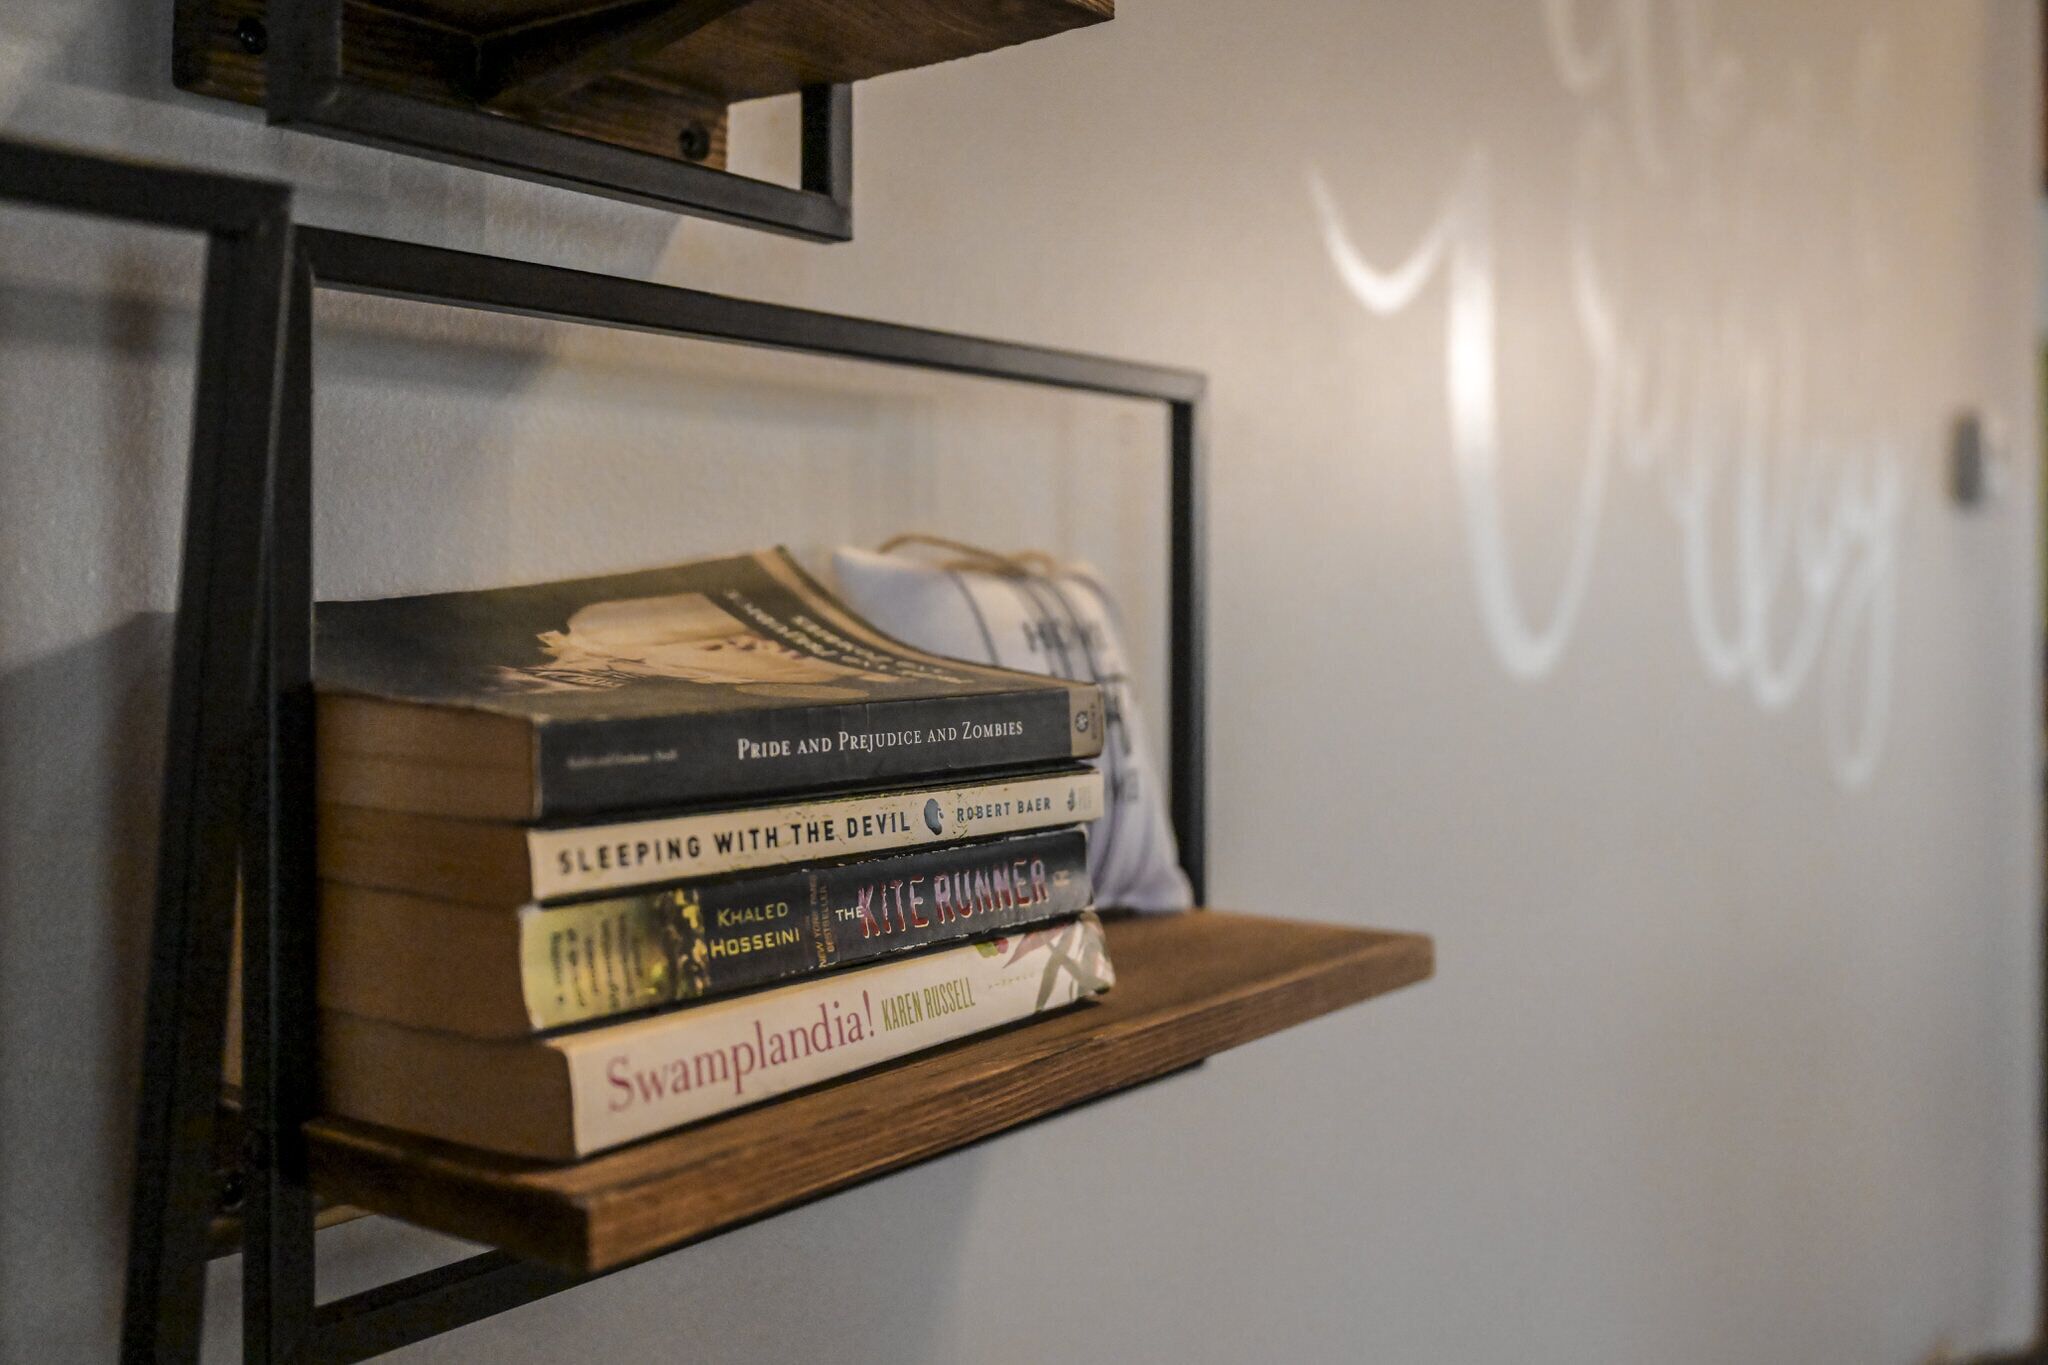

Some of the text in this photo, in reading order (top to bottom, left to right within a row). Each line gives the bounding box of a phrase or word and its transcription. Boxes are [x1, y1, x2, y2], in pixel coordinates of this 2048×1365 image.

[737, 720, 1023, 761] PRIDE AND PREJUDICE AND ZOMBIES
[956, 796, 1051, 822] ROBERT BAER
[557, 811, 910, 875] SLEEPING WITH THE DEVIL
[716, 901, 789, 928] KHALED
[835, 857, 1050, 939] THE KITE RUNNER
[710, 928, 800, 958] HOSSEINI
[881, 996, 924, 1032] KAREN
[926, 977, 976, 1022] RUSSELL
[605, 989, 876, 1113] Swamplandia!
